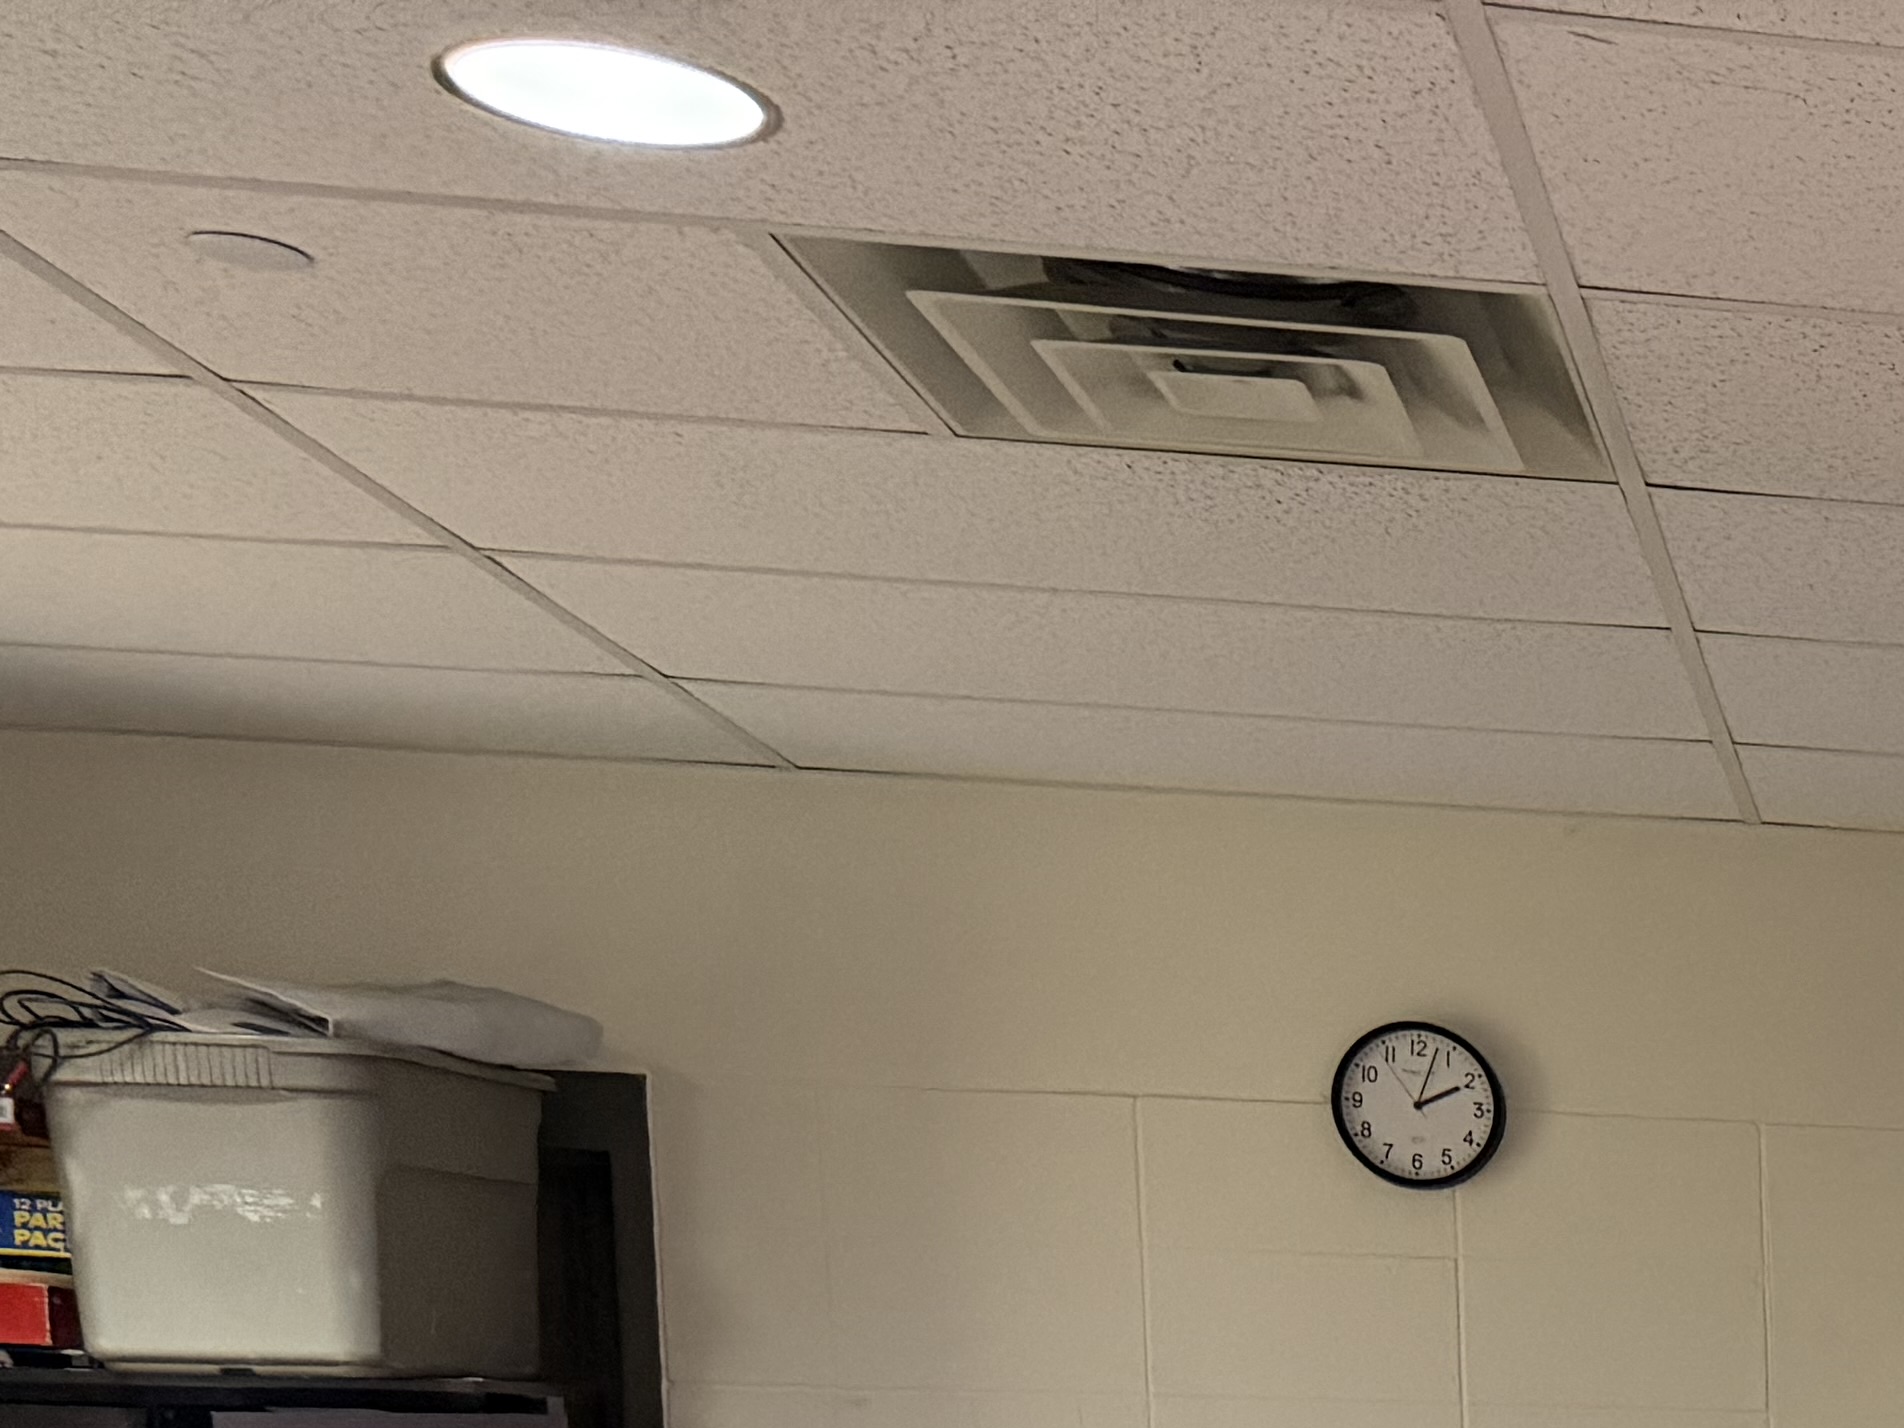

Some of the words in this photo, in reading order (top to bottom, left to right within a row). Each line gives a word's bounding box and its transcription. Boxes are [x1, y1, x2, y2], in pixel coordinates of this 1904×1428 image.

[1385, 1045, 1396, 1063] 11
[1410, 1039, 1428, 1057] 12
[1361, 1065, 1378, 1083] 10
[1464, 1073, 1475, 1090] 2
[1352, 1091, 1363, 1108] 9
[1473, 1102, 1485, 1119] 3
[1360, 1121, 1372, 1138] 8
[1462, 1130, 1473, 1147] 4
[1383, 1143, 1394, 1159] 7
[1441, 1148, 1453, 1166] 5
[1411, 1153, 1423, 1170] 6
